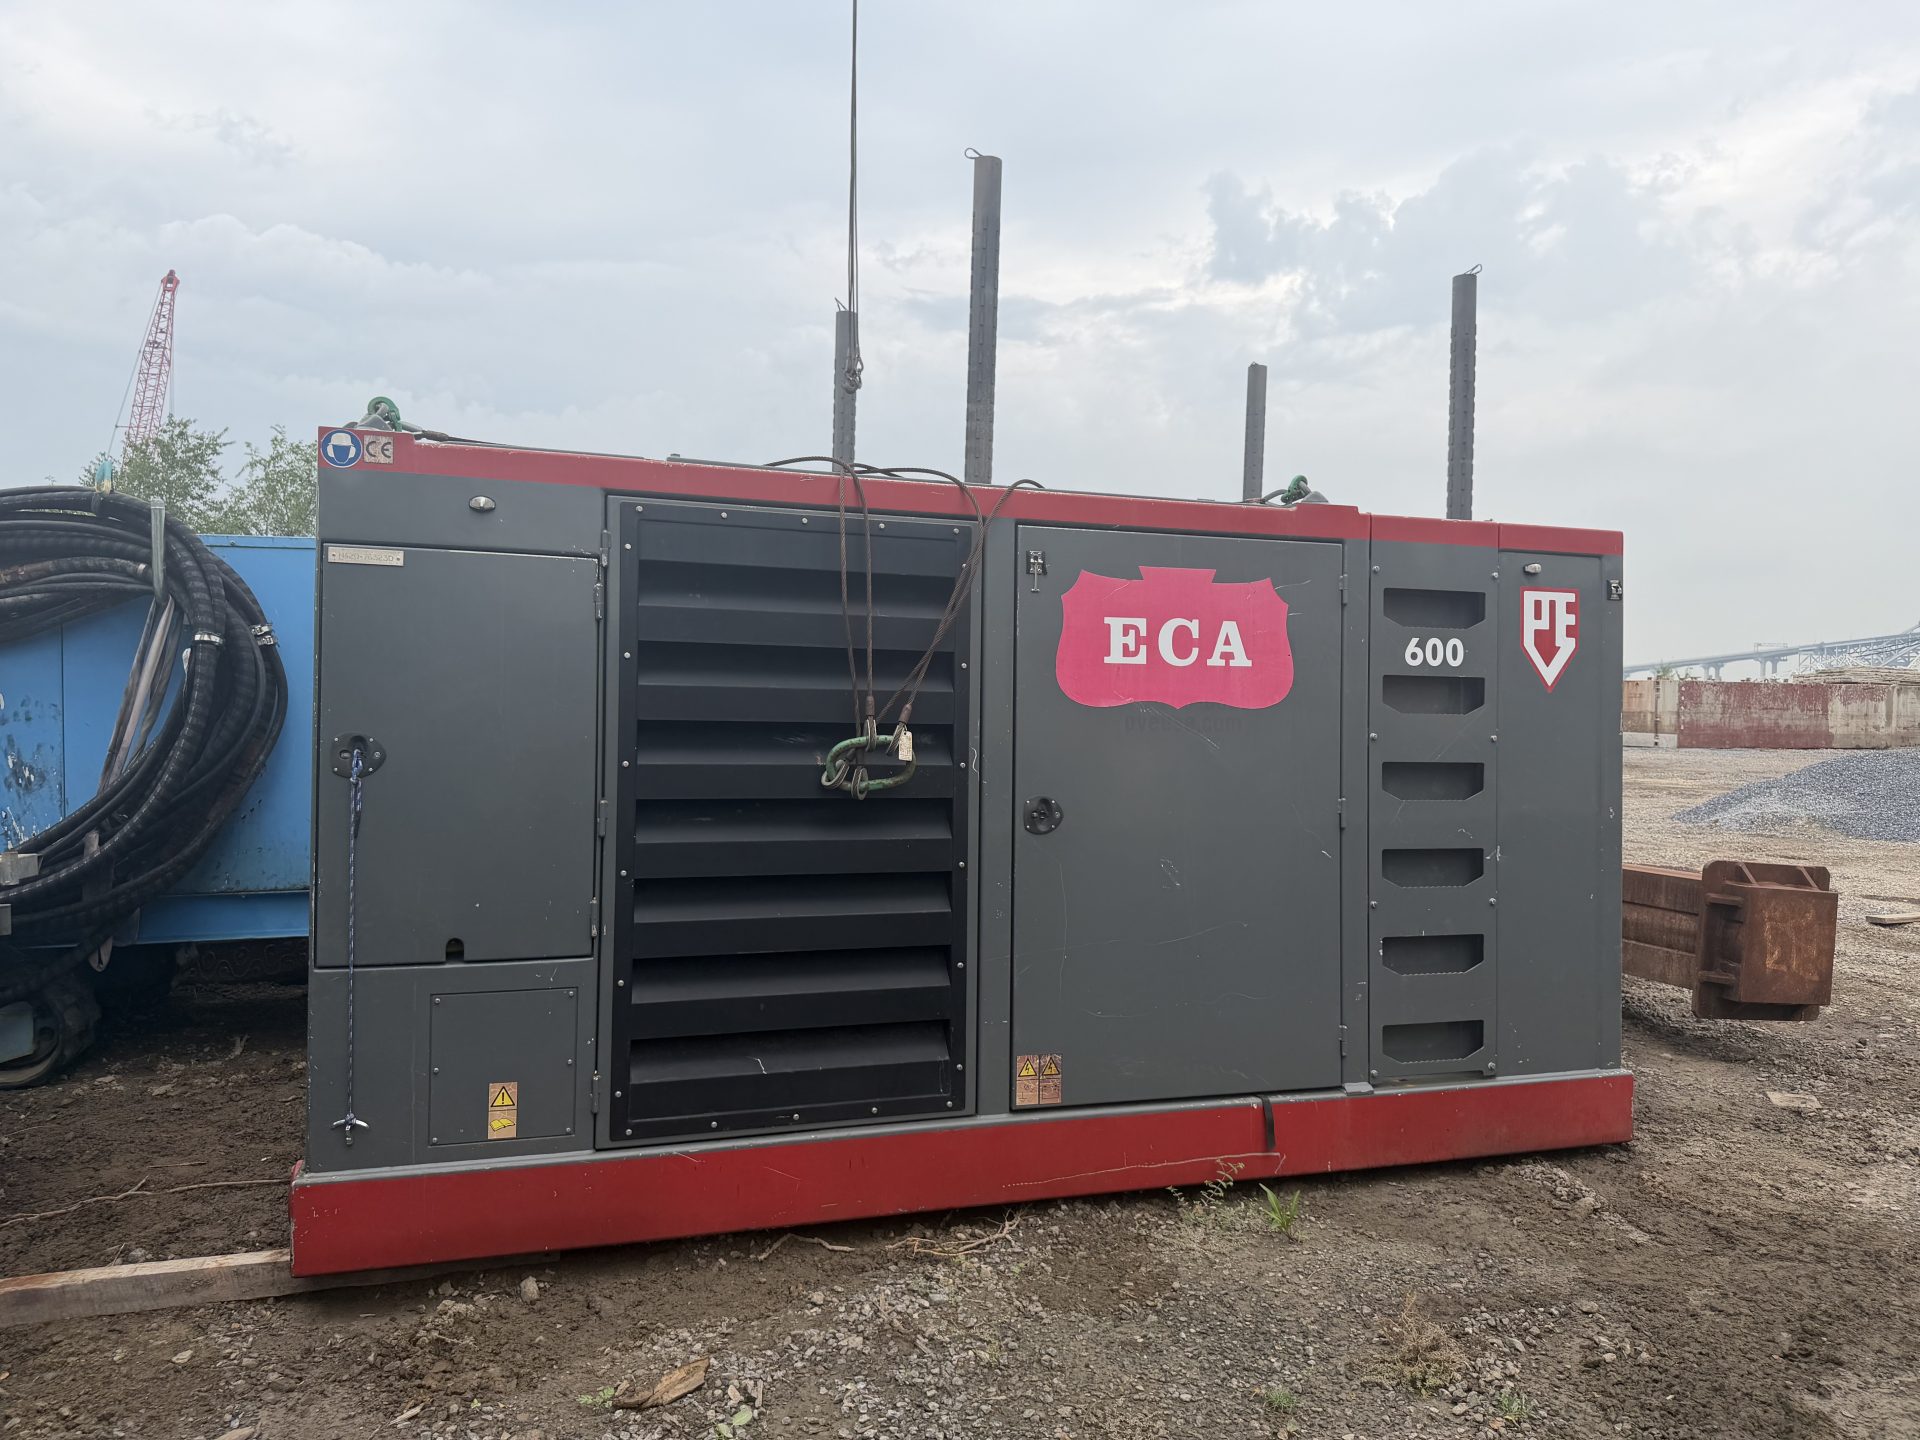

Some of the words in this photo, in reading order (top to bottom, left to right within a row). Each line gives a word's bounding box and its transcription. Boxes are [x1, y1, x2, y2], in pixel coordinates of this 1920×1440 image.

[365, 440, 392, 459] CE
[1103, 616, 1253, 667] ECA
[1404, 637, 1464, 667] 600
